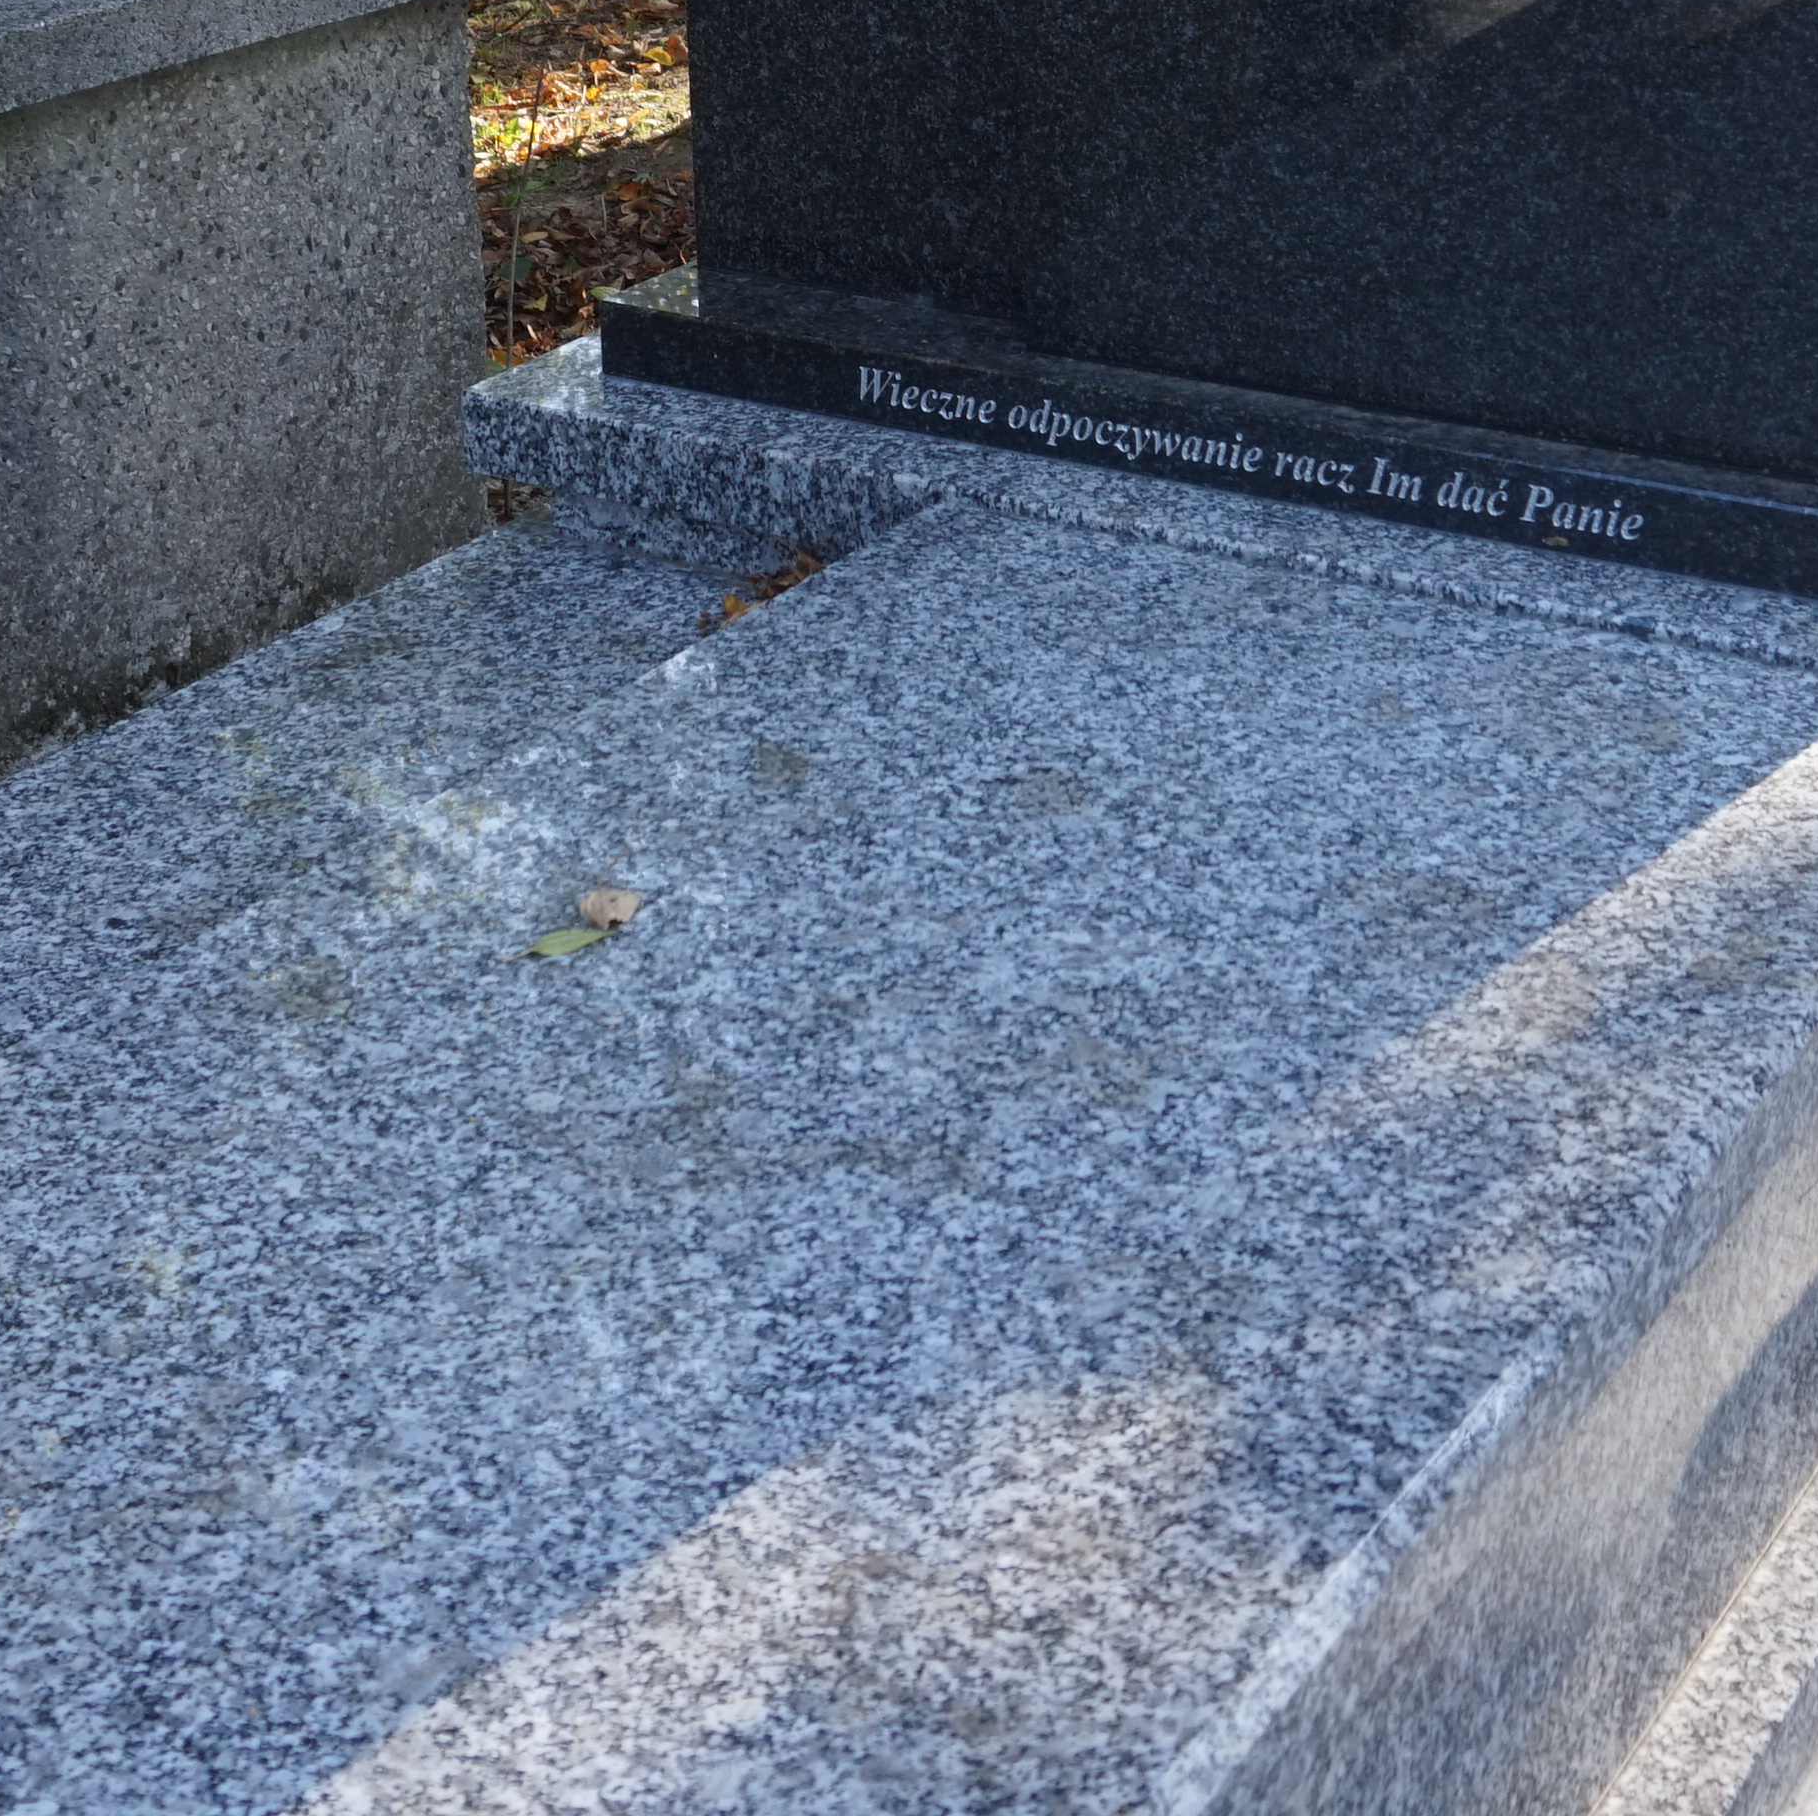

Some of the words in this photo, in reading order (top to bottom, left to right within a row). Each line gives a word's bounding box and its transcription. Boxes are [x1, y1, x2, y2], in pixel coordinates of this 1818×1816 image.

[859, 366, 997, 424] Wieczne
[1007, 401, 1263, 474] odpoczywanie
[1274, 452, 1354, 494] racz
[1367, 457, 1422, 502] Im
[1436, 471, 1508, 517] dać
[1520, 484, 1644, 541] Panie
